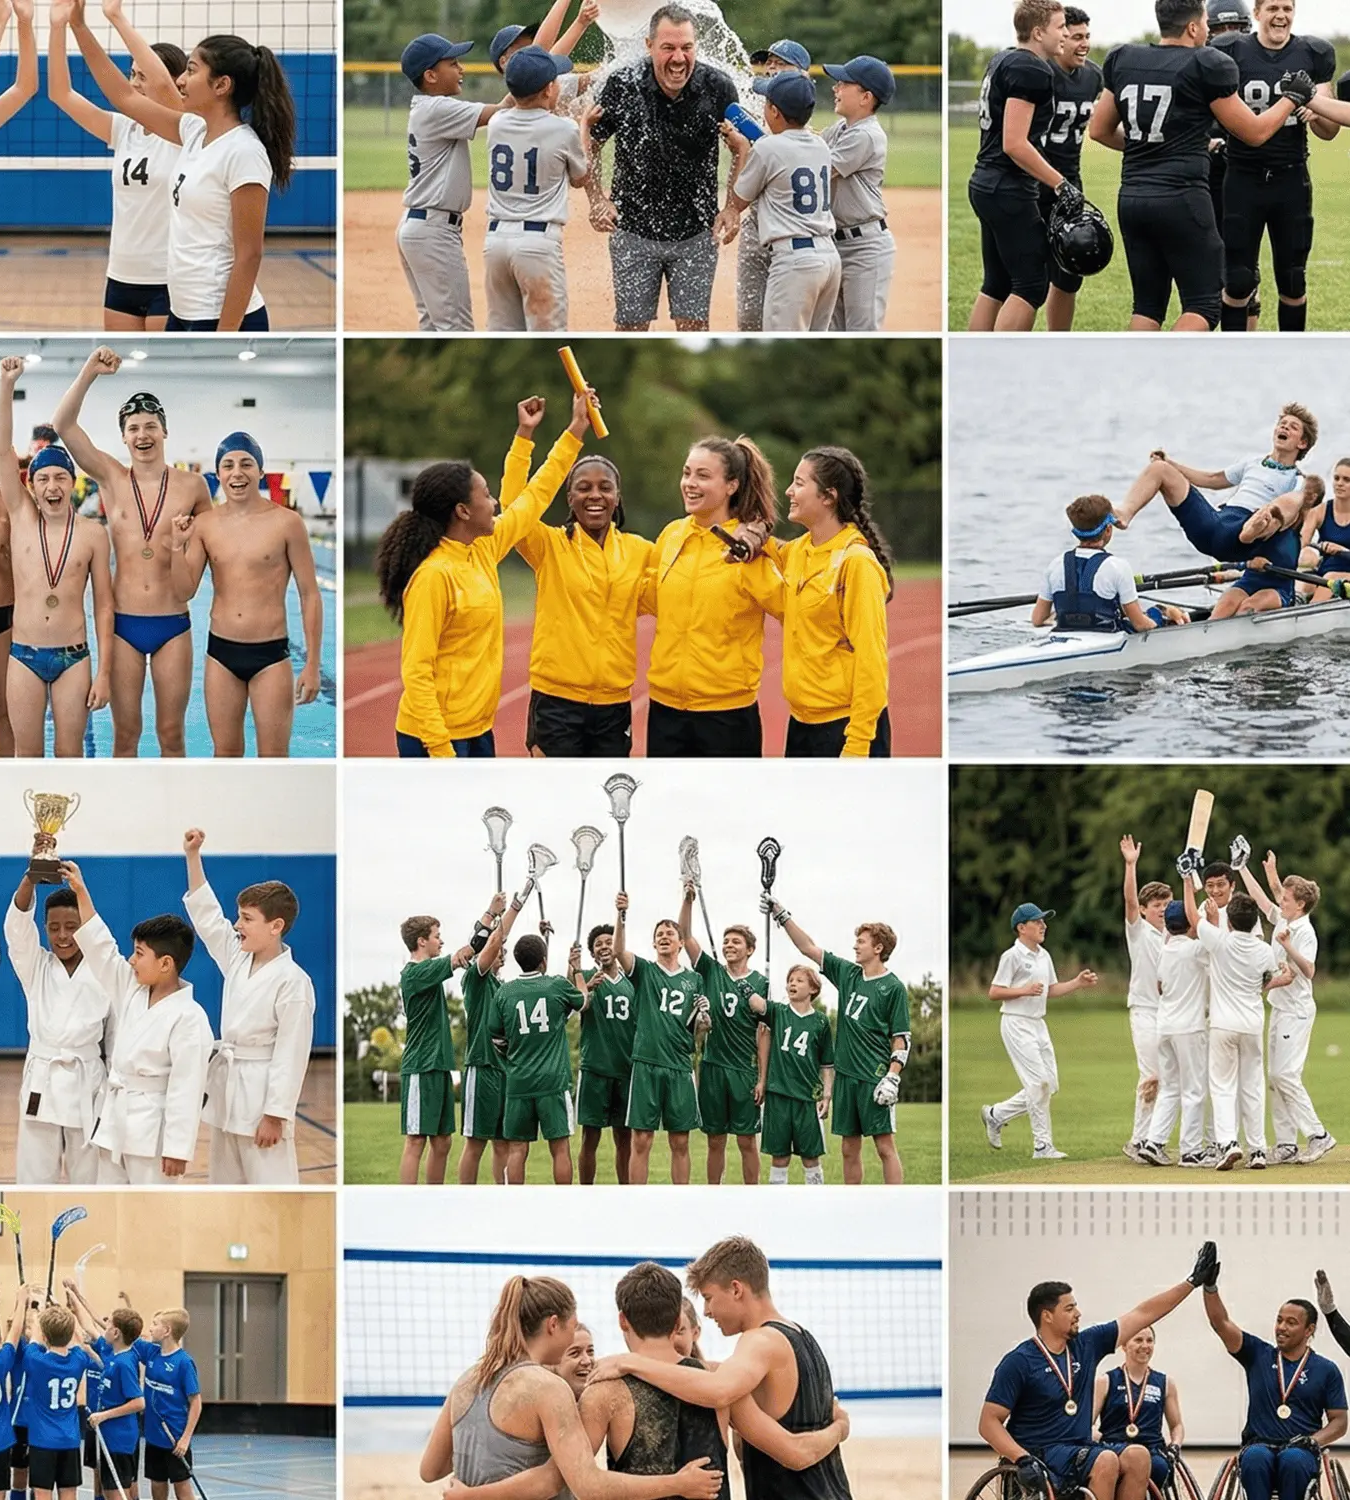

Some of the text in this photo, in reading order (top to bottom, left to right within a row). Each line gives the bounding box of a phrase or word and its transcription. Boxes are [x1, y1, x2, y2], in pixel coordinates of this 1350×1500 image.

[1120, 84, 1172, 142] 17
[123, 157, 148, 186] 14
[491, 144, 540, 195] 81
[791, 165, 830, 214] 81
[516, 998, 549, 1035] 14
[604, 995, 630, 1020] 13
[660, 988, 685, 1015] 12
[845, 992, 869, 1020] 17
[781, 1026, 809, 1057] 14
[48, 1377, 78, 1409] 13
